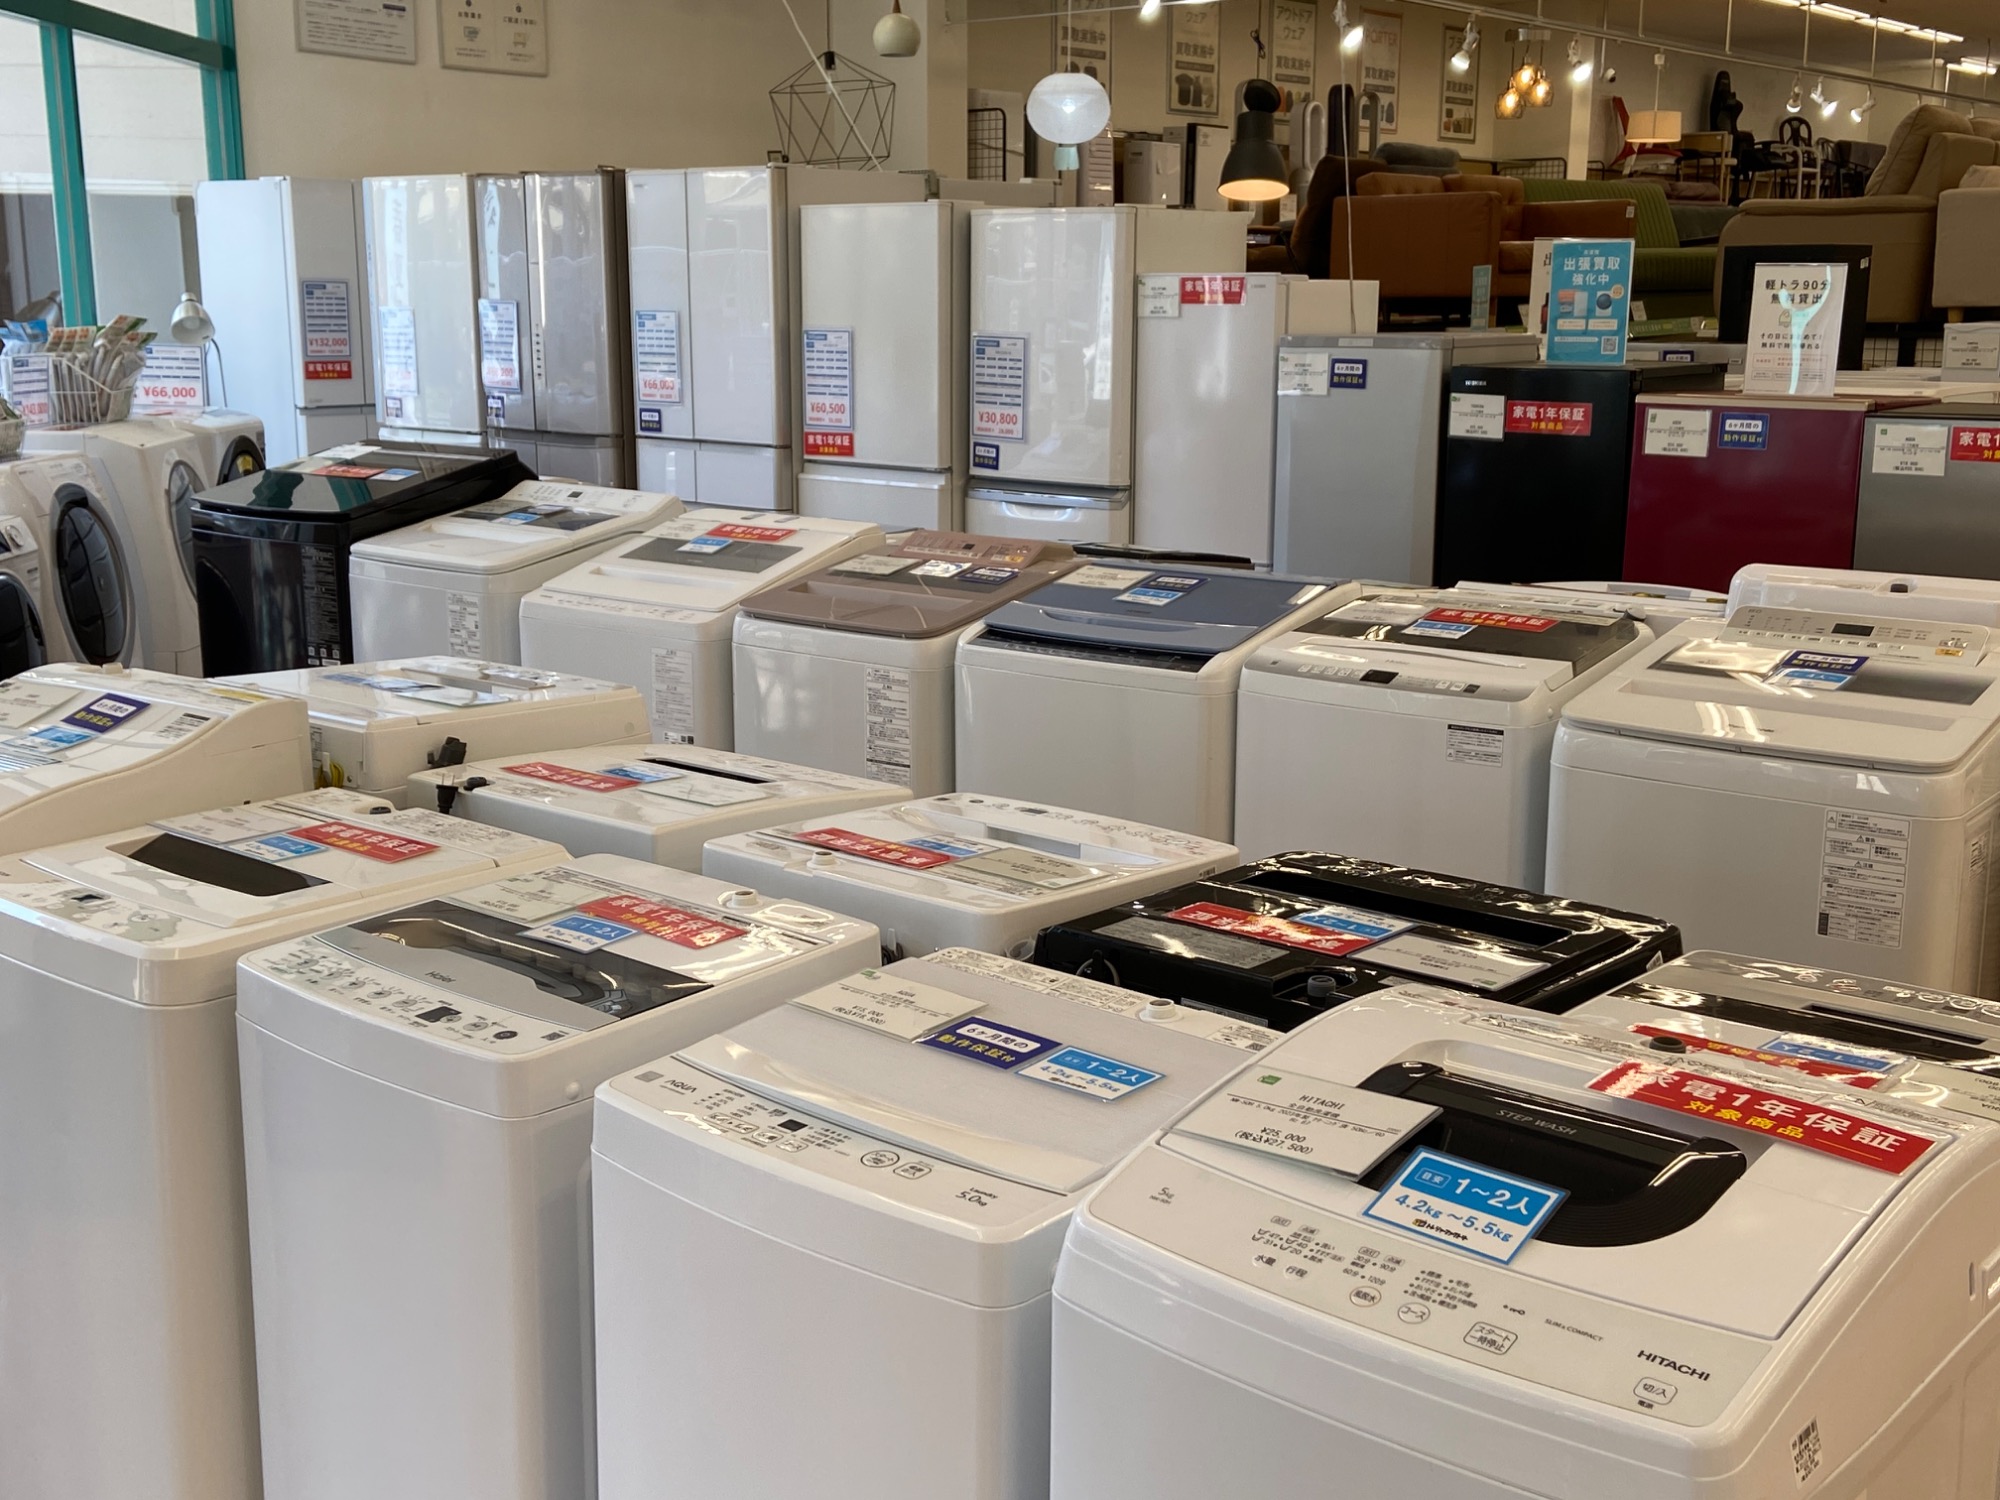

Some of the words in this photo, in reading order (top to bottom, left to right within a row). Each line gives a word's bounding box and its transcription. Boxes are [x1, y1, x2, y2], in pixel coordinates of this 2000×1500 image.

[1563, 256, 1620, 271] 出張買取
[1572, 273, 1610, 286] 強化中
[309, 337, 348, 348] ¥132,000
[143, 386, 197, 399] ¥66,000
[810, 402, 846, 415] ¥60,500
[1513, 405, 1585, 421] 家電1年保証
[978, 411, 1018, 426] ¥30,800
[1728, 422, 1759, 430] 6ヶ月間の
[807, 434, 851, 446] 家電1年保証
[1724, 433, 1762, 443] 動作保証付
[1439, 610, 1549, 627] 家電1年保証
[319, 824, 427, 854] 家電1年保証
[611, 896, 735, 946] 家電1年保証
[580, 921, 618, 939] 1〜2人
[424, 969, 455, 984] Haier
[966, 1026, 1029, 1050] 6ヶ月間の
[935, 1033, 1015, 1063] 動作保証付
[1085, 1060, 1139, 1083] 1〜2人
[664, 1079, 697, 1093] AQUA
[1298, 1094, 1346, 1110] HITACHI
[1645, 1071, 1908, 1154] 家電1年保証
[1684, 1100, 1805, 1140] 対象商品
[1494, 1108, 1533, 1124] STEP
[1533, 1119, 1578, 1137] WASH
[1234, 1129, 1314, 1155] (税込¥27,500)
[954, 1190, 988, 1207] 5.0kg
[1157, 1186, 1176, 1200] 5kg
[1421, 1169, 1445, 1185] 目安
[1455, 1178, 1529, 1215] 1〜2人
[1395, 1193, 1514, 1243] 4.2kg〜5.5kg
[1289, 1247, 1302, 1255] 20
[1254, 1254, 1277, 1267] 水量
[1285, 1265, 1308, 1277] 行程
[1368, 1275, 1386, 1286] 120分
[1401, 1305, 1427, 1321] コース
[1475, 1325, 1512, 1343] スタート
[1566, 1325, 1604, 1343] COMPACT
[1469, 1334, 1506, 1352] 一時停止
[1636, 1349, 1711, 1382] HITACHI
[1642, 1382, 1668, 1399] 切/入
